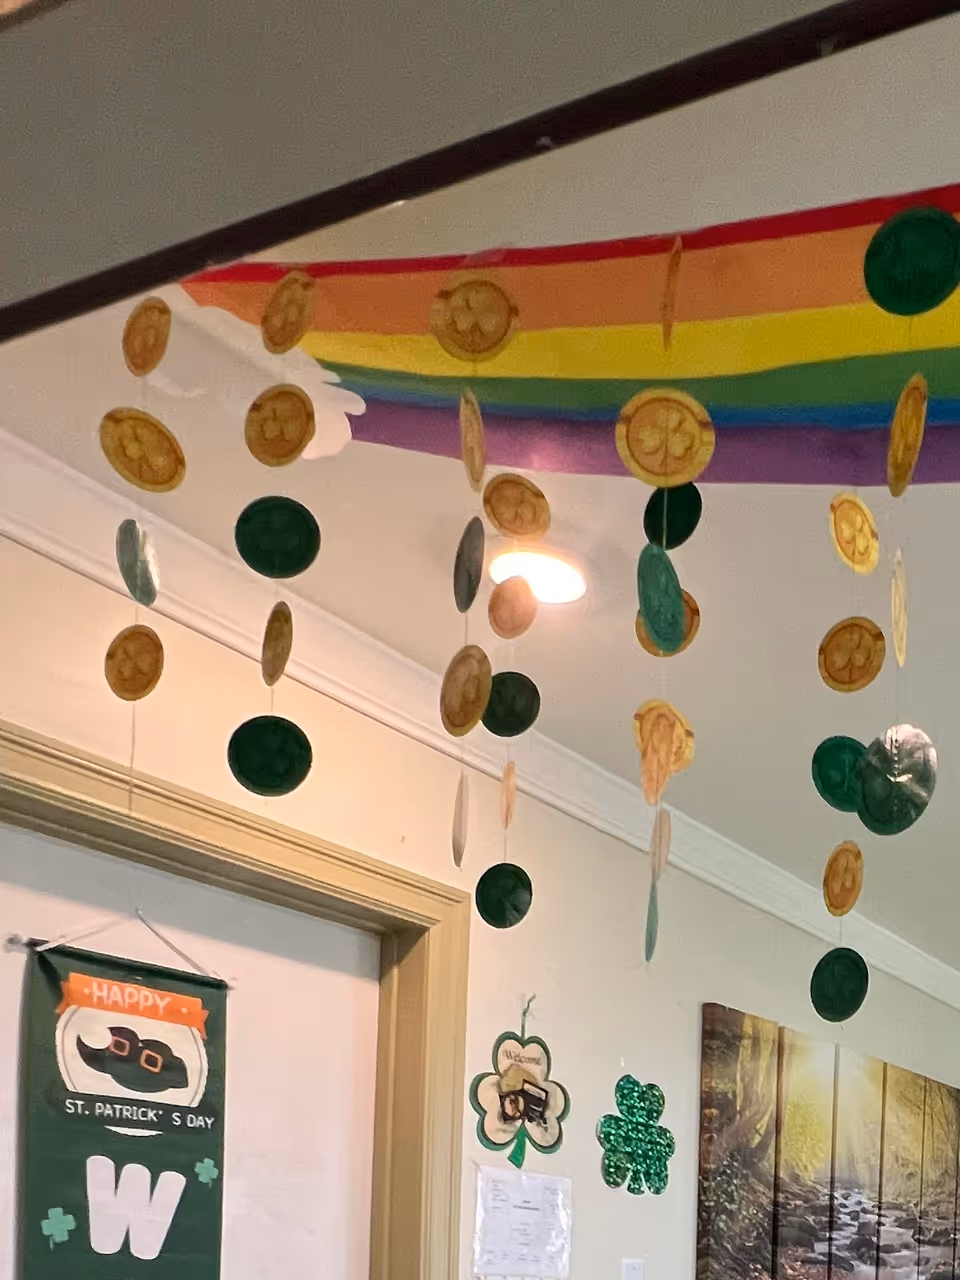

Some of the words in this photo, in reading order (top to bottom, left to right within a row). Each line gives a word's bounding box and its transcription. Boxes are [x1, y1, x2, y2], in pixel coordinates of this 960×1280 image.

[91, 981, 173, 1015] HAPPY
[501, 1049, 542, 1066] Welcome
[64, 1099, 90, 1116] ST.
[186, 1113, 216, 1130] DAY
